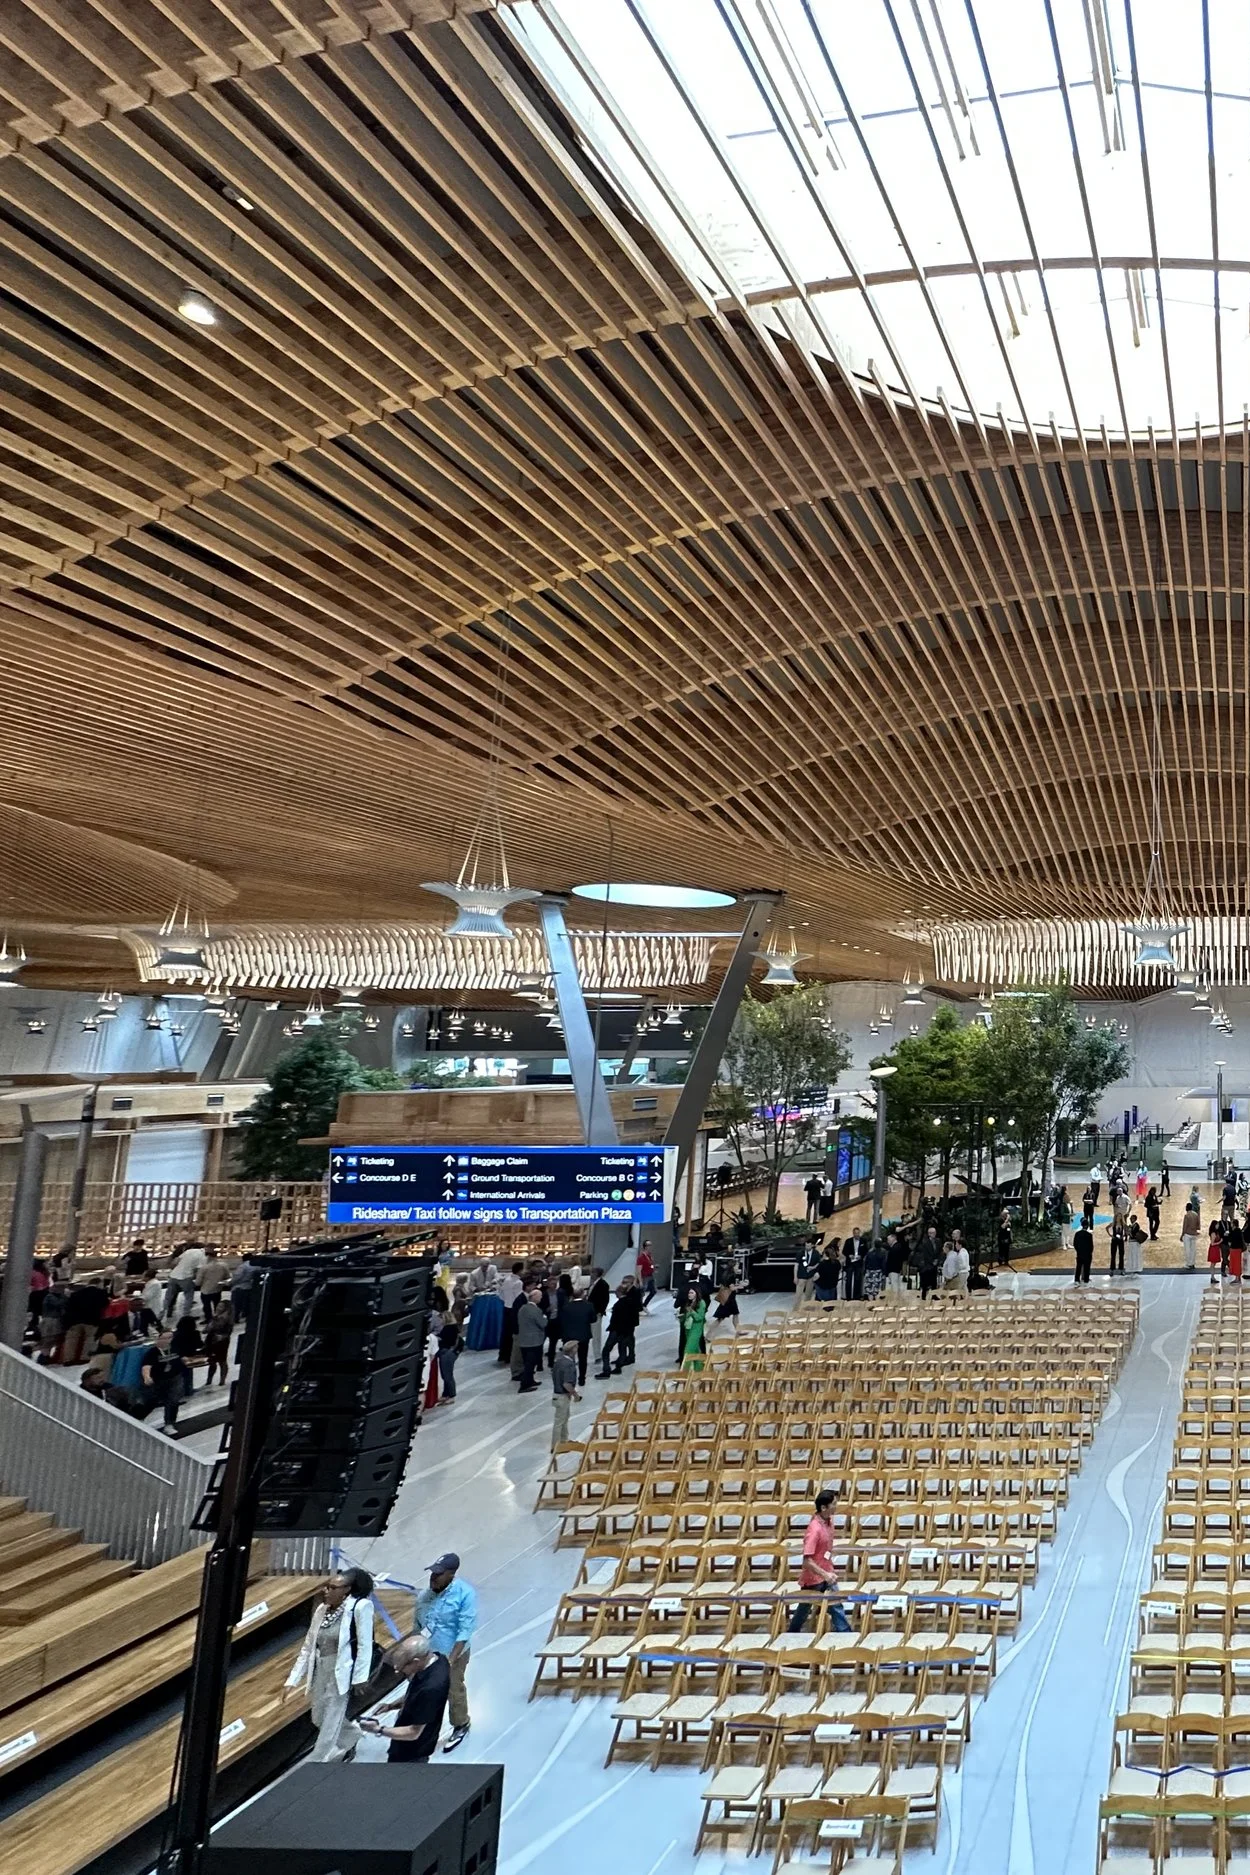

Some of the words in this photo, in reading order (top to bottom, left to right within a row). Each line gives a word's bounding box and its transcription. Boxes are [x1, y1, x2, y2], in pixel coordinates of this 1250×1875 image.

[360, 1157, 394, 1166] Ticketing
[471, 1157, 505, 1166] Baggage
[506, 1157, 528, 1165] Claim
[600, 1157, 634, 1166] Ticketing
[360, 1174, 400, 1182] Concourse
[502, 1174, 555, 1183] Transportation
[576, 1174, 618, 1182] Concourse
[626, 1174, 634, 1182] C
[470, 1191, 516, 1200] International
[518, 1192, 546, 1200] Arrivals
[580, 1192, 608, 1200] Parking
[352, 1207, 412, 1220] Rideshare/
[414, 1208, 436, 1219] Taxi
[438, 1207, 470, 1220] follow
[473, 1208, 504, 1222] signs
[506, 1208, 518, 1220] to
[520, 1208, 599, 1222] Transportation
[602, 1208, 632, 1220] Plaza
